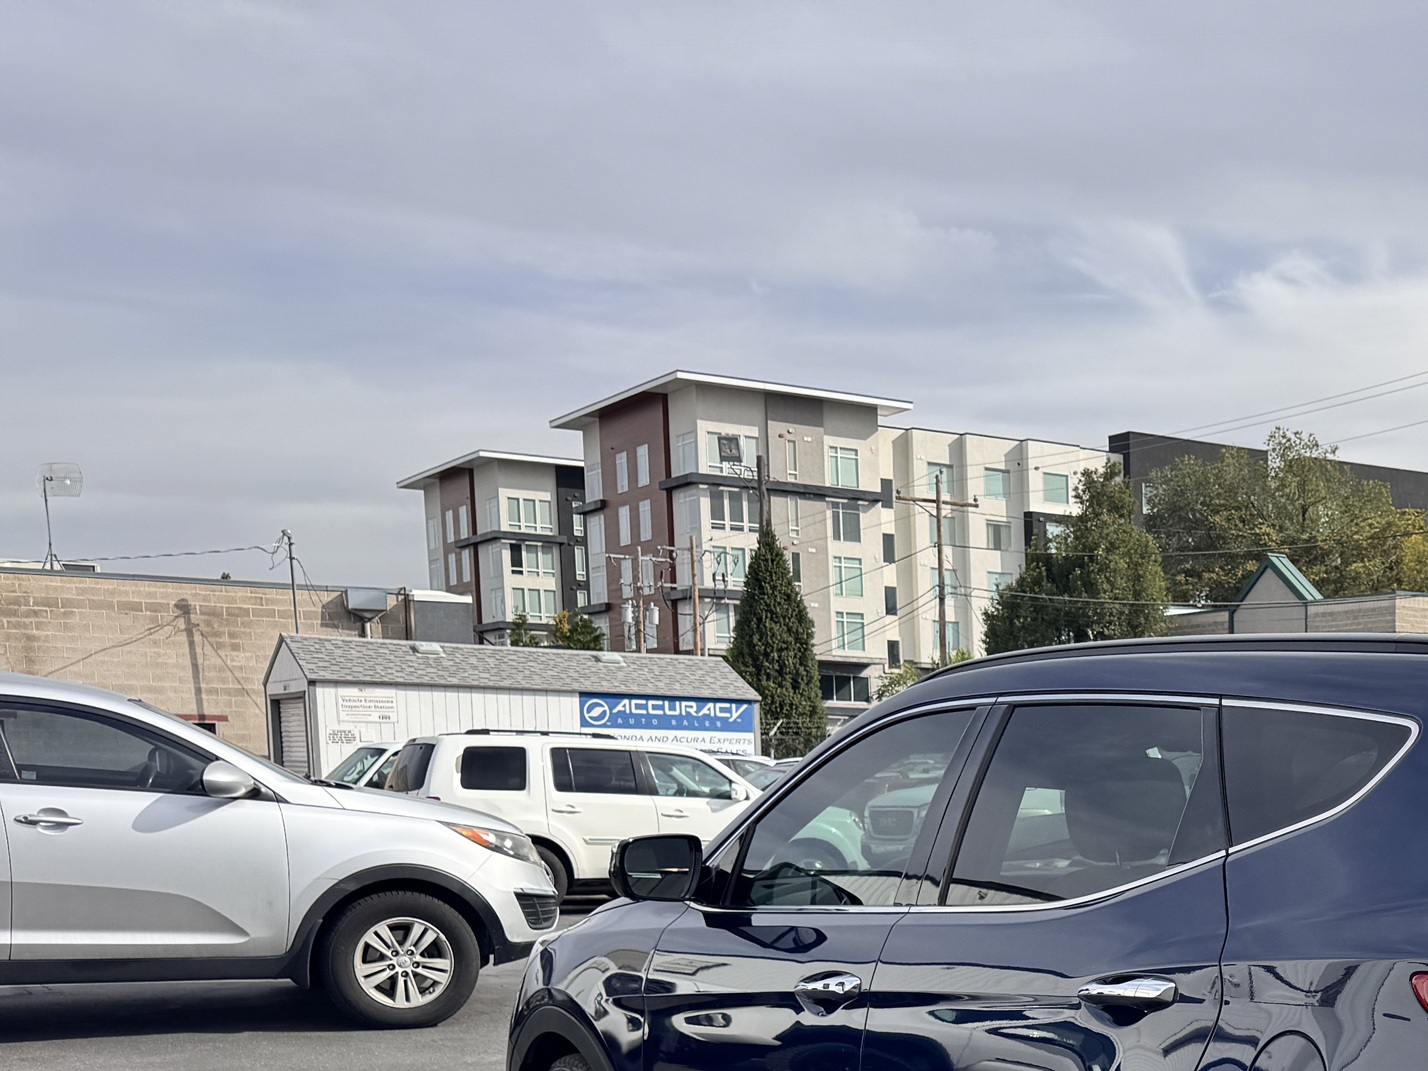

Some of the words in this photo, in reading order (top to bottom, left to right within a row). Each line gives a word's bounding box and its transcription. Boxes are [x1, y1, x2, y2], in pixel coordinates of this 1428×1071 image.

[612, 699, 749, 723] ACCURACY
[617, 717, 659, 725] AUTO
[671, 719, 722, 728] SALES
[614, 733, 644, 742] ONDA
[647, 735, 669, 743] AND
[671, 735, 706, 744] ACURA
[709, 736, 753, 746] EXPERTS
